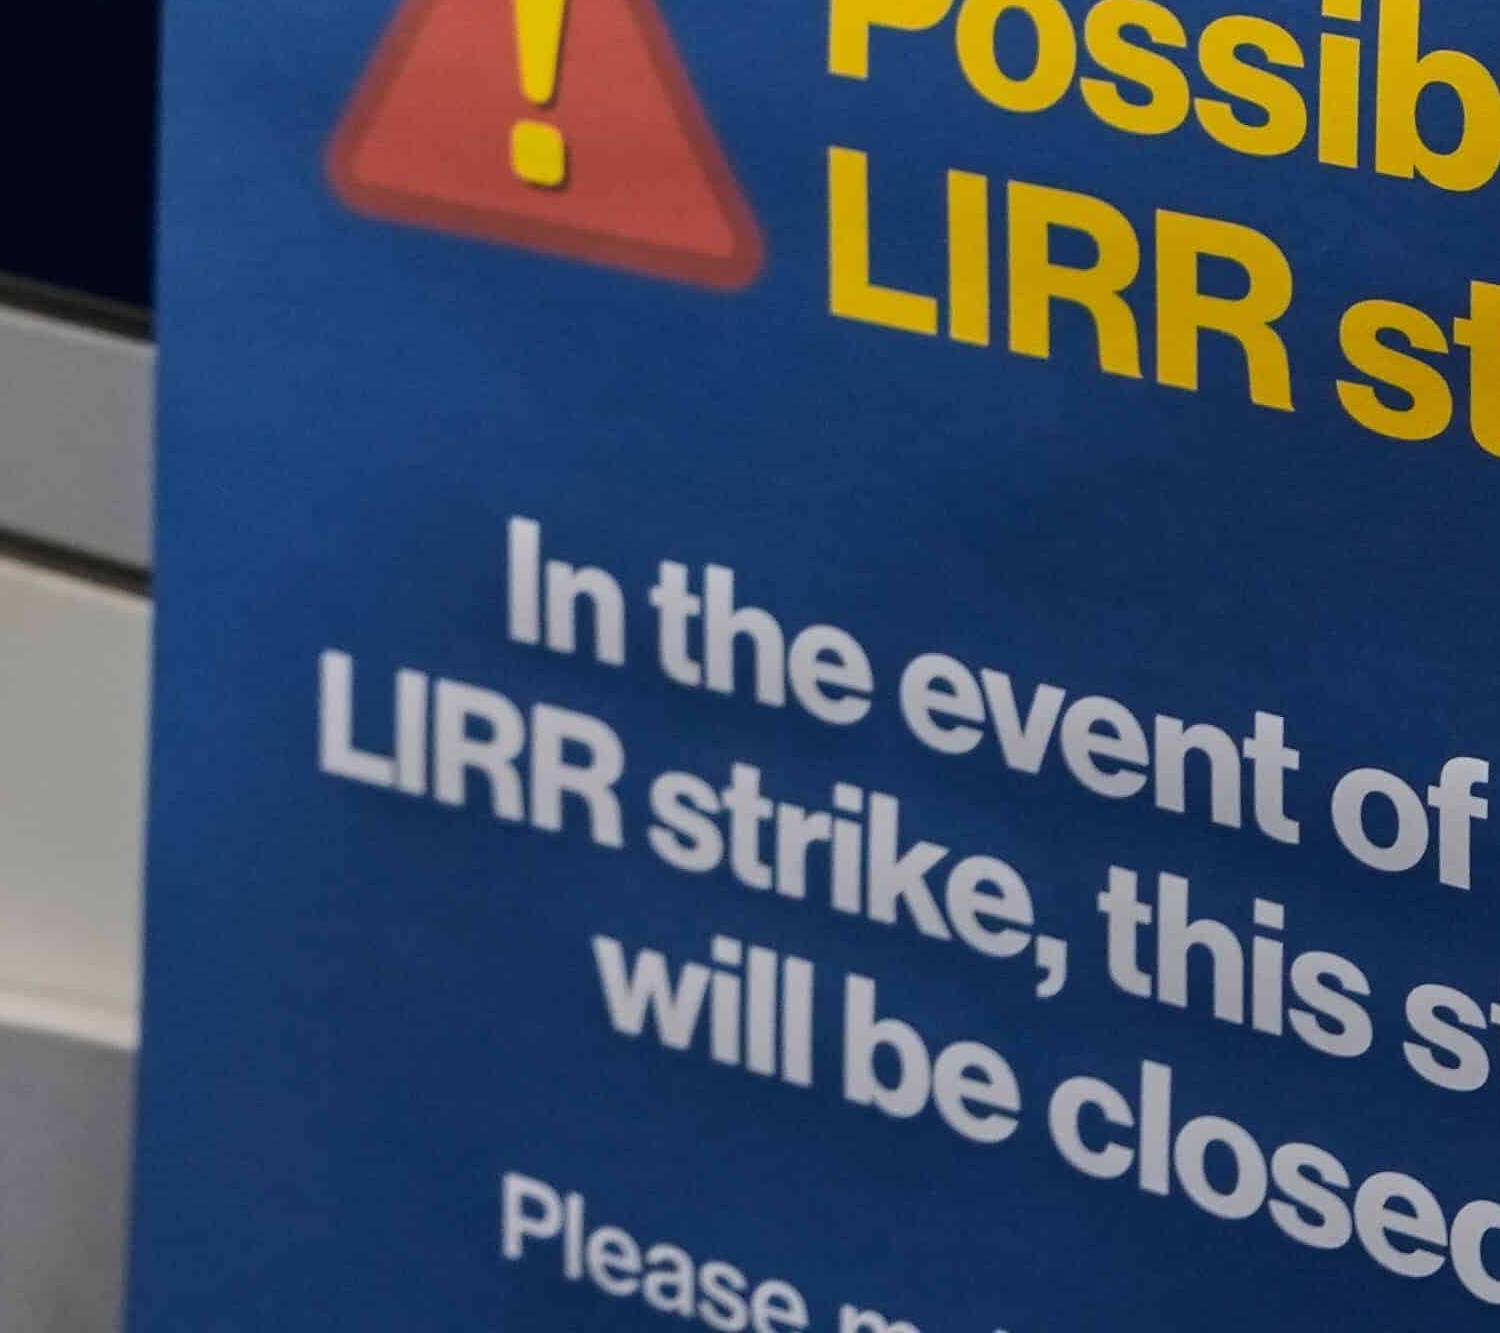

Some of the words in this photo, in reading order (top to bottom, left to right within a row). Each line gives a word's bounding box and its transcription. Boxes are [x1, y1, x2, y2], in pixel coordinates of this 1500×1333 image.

[828, 146, 1295, 413] LIRR
[508, 515, 625, 666] In
[650, 560, 875, 726] the
[900, 652, 1300, 845] event
[1330, 756, 1490, 890] of
[319, 648, 624, 849] LIRR
[648, 761, 1067, 999] strike,
[1098, 865, 1373, 1058] this
[593, 935, 814, 1088] will
[843, 973, 1021, 1145] be
[502, 1171, 809, 1333] Please
